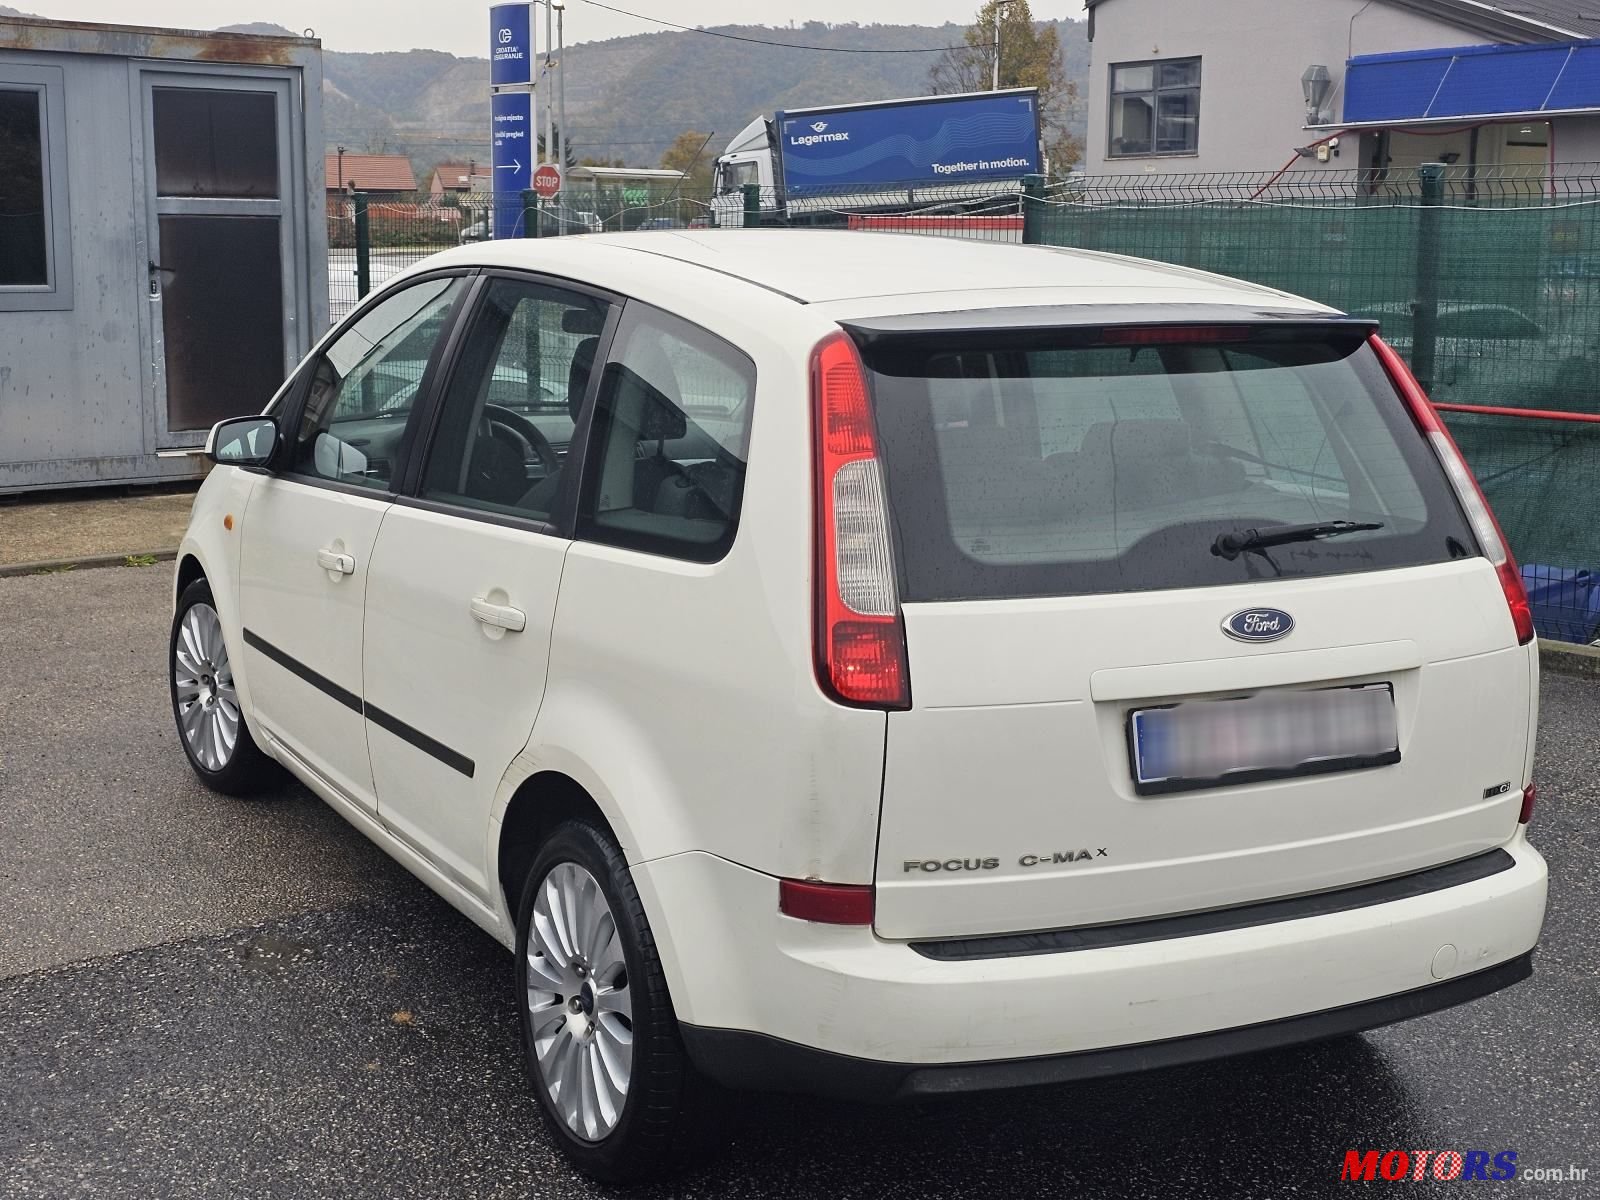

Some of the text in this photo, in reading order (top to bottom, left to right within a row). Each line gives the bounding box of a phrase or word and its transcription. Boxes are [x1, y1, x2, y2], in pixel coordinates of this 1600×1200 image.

[790, 131, 849, 146] Lagermax
[931, 157, 1030, 174] Together in motion.
[536, 176, 558, 187] STOP
[1243, 613, 1280, 633] Ford
[903, 857, 1000, 873] FOCUS
